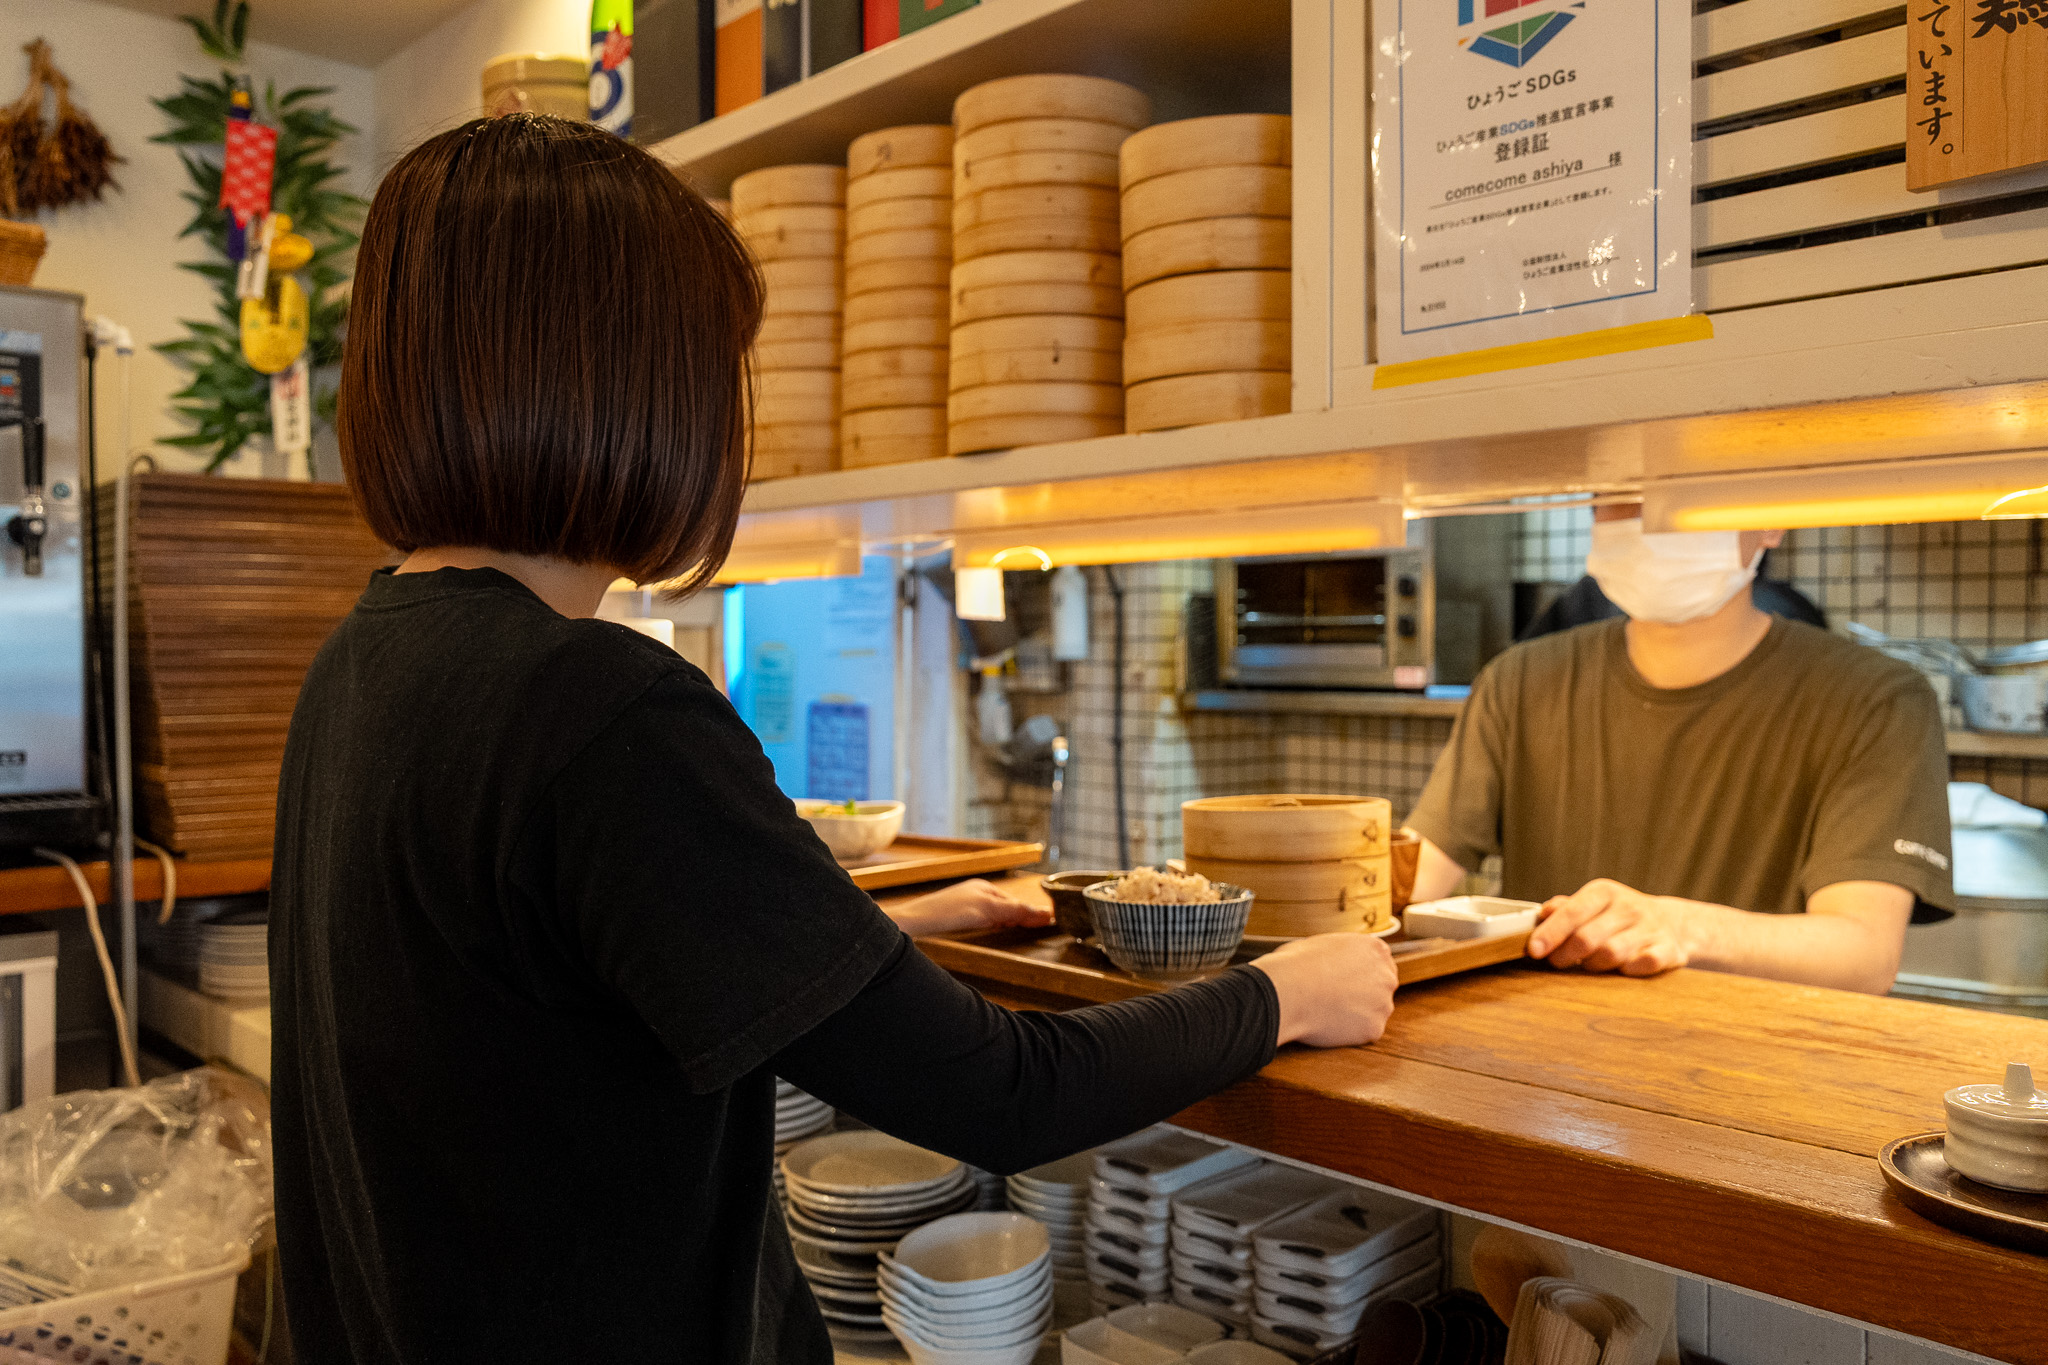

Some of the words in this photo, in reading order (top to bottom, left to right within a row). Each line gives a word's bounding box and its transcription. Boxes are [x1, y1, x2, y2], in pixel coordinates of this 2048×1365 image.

[1916, 0, 1953, 155] ています。
[1495, 132, 1550, 163] 登録証
[1445, 172, 1527, 201] comecome
[1533, 158, 1583, 180] ashiya
[1609, 151, 1623, 168] 様
